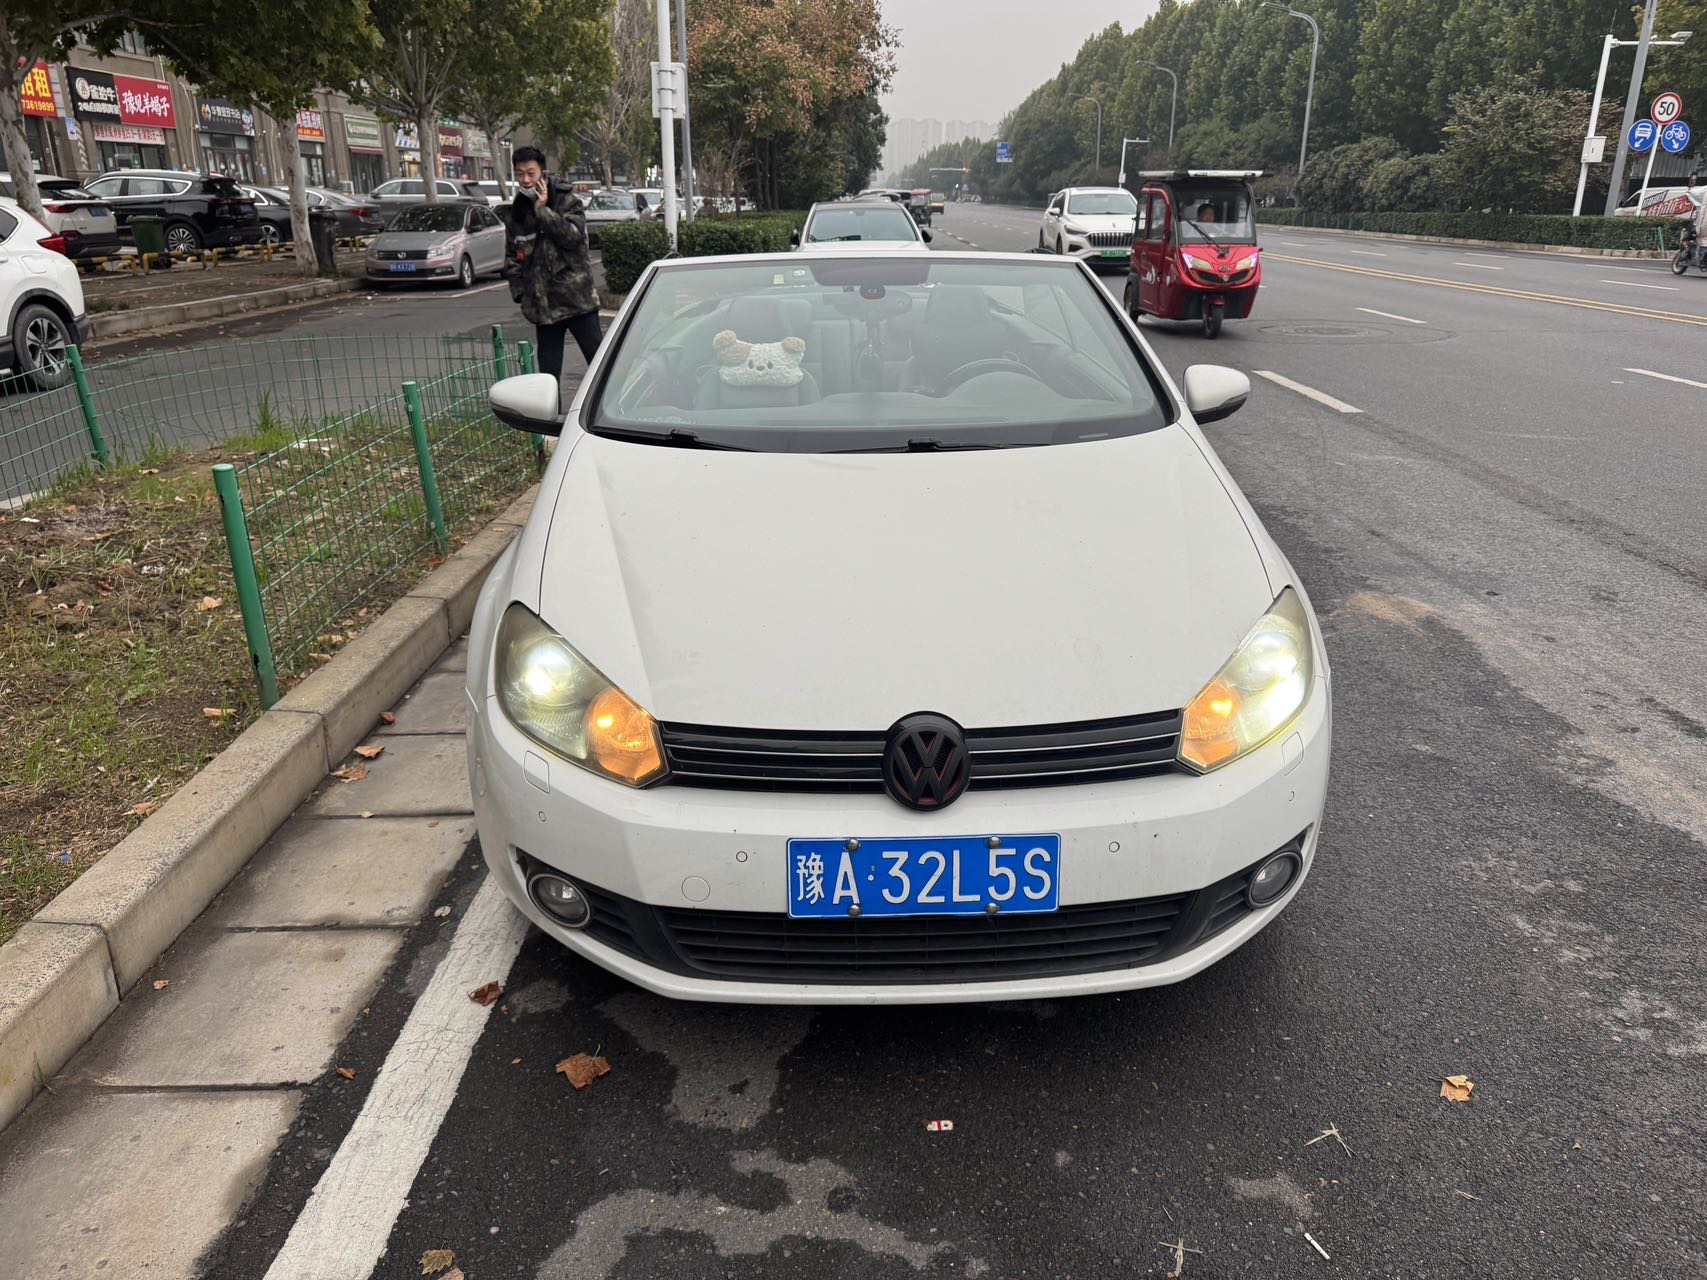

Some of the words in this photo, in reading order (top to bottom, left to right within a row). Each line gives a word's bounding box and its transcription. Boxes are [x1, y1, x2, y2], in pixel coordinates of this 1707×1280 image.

[122, 89, 170, 118] 豫见羊蝎子
[1658, 101, 1675, 116] 50
